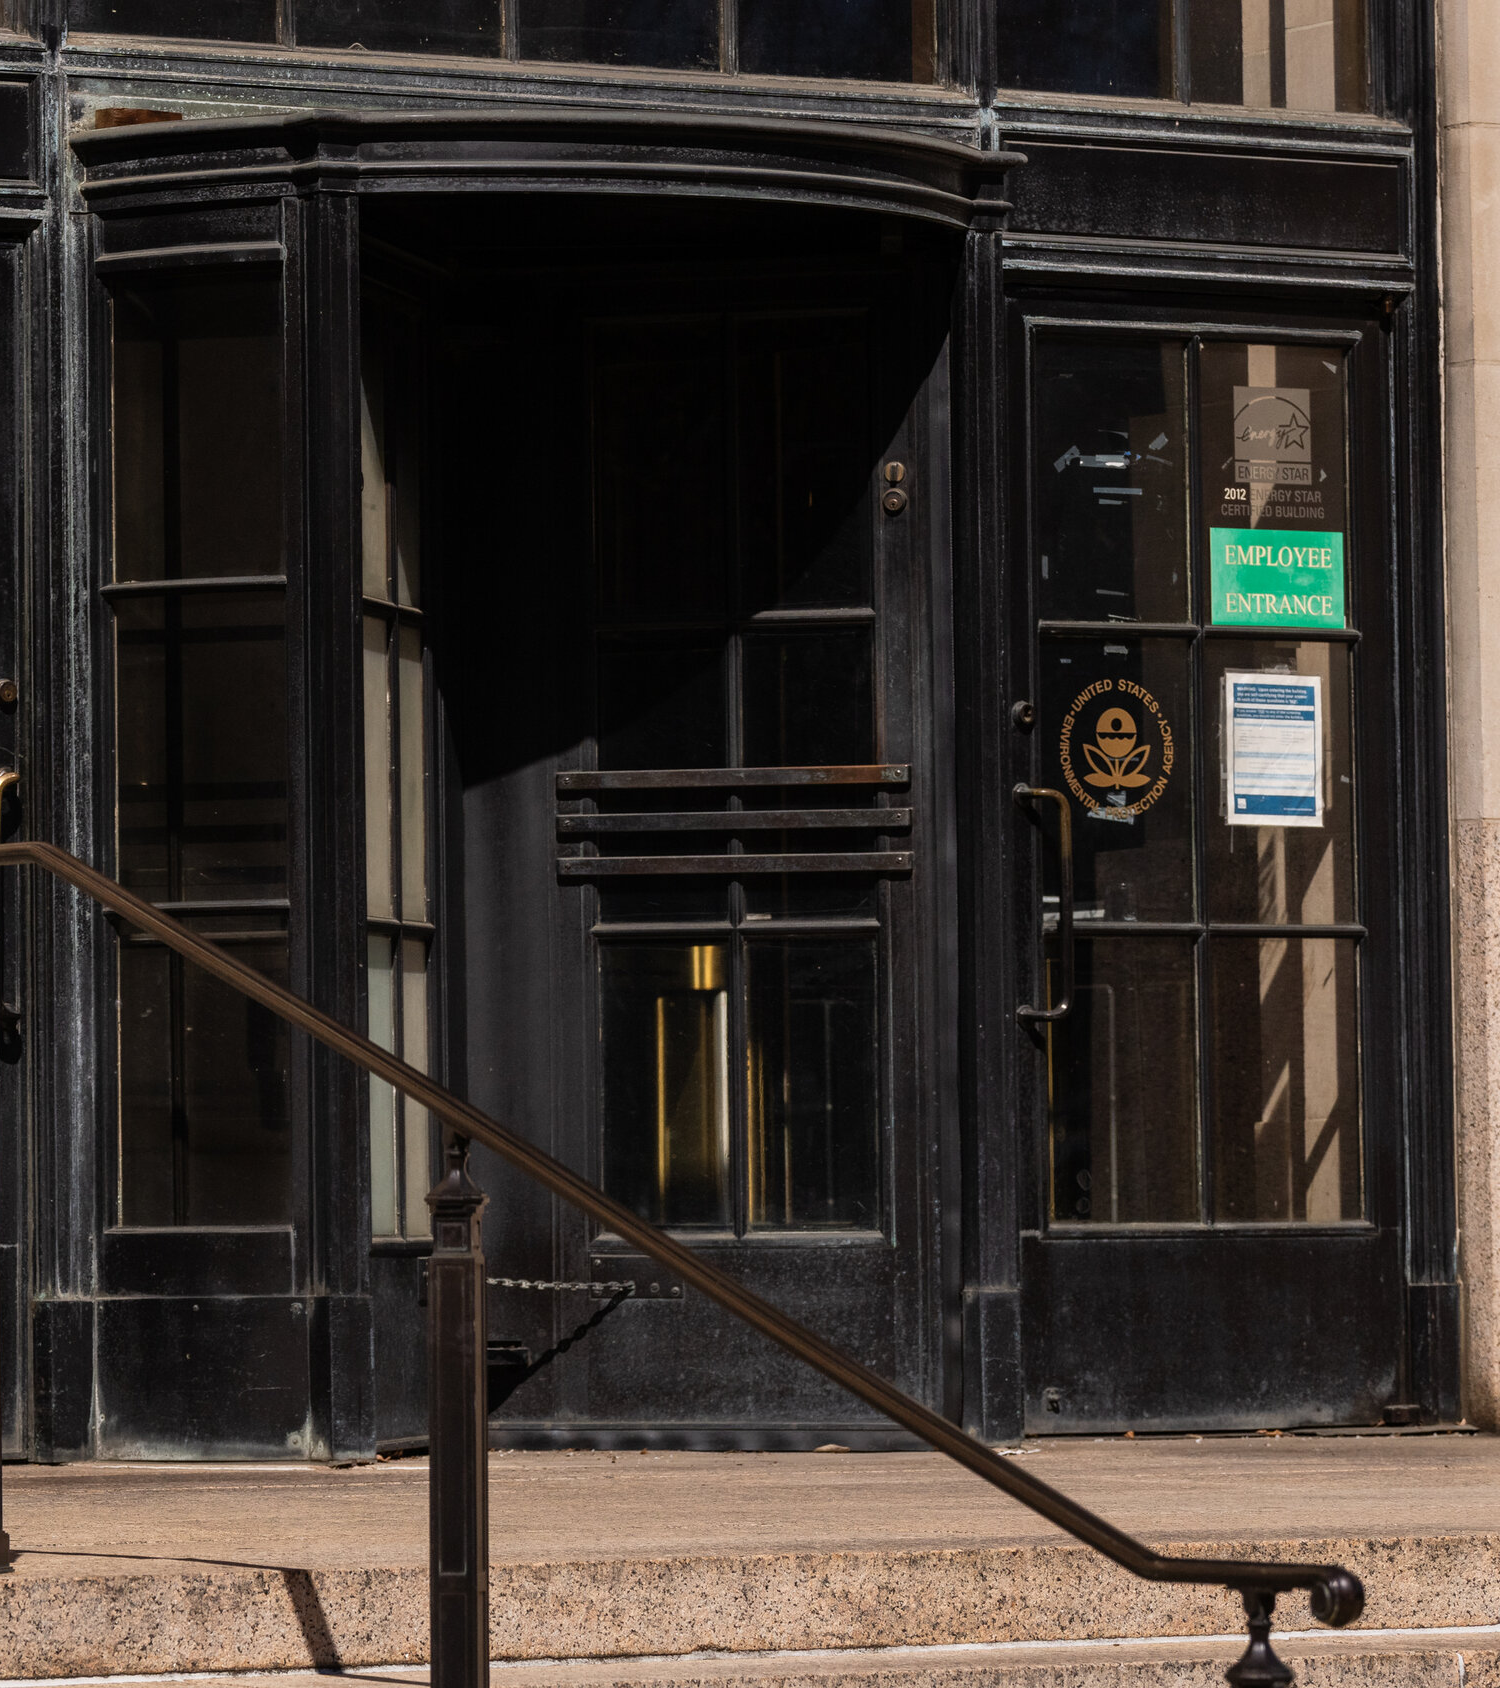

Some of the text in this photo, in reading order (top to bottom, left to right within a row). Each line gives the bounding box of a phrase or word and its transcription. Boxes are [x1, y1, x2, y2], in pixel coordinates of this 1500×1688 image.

[1282, 467, 1309, 482] STAR
[1224, 487, 1322, 503] 2012 ENERGY STAR
[1275, 505, 1325, 519] BUILDING
[1224, 544, 1332, 569] EMPLOYEE
[1225, 592, 1333, 617] ENTRANCE
[1071, 679, 1159, 713] UNITED STATES
[1060, 714, 1174, 820] ENVIRONMENTAL PROTECTION AGENCY
